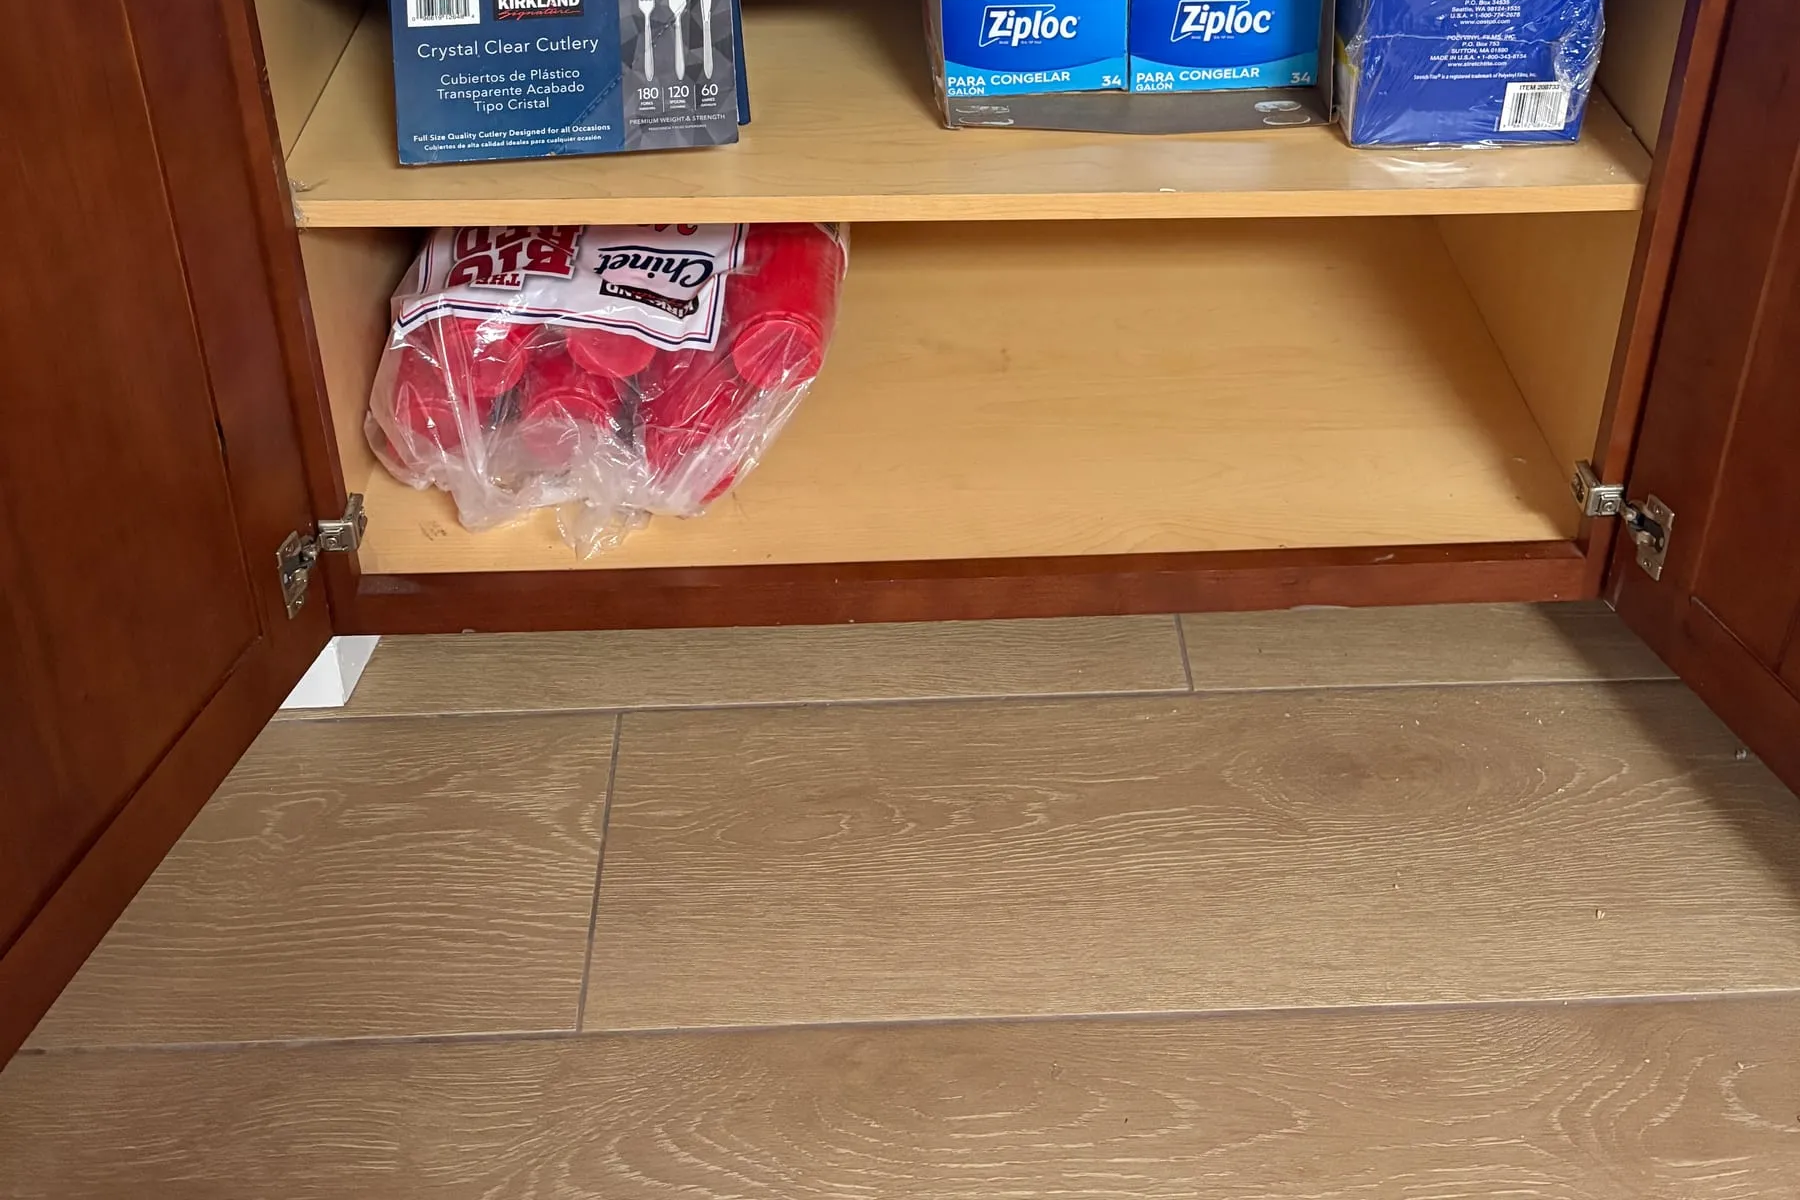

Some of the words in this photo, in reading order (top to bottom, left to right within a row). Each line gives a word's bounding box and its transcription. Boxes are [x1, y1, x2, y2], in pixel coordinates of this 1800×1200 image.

[498, 7, 581, 20] Signature
[988, 9, 1078, 47] Ziploc
[1180, 4, 1272, 42] Ziploc
[417, 40, 478, 61] Crystal
[485, 40, 530, 54] Clear
[536, 36, 599, 53] Cutlery
[440, 73, 505, 86] Cubiertos
[510, 70, 526, 82] de
[530, 68, 580, 80] Plástico
[948, 76, 986, 87] PARA
[990, 71, 1070, 85] CONGELAR
[1102, 75, 1122, 87] 34
[1136, 72, 1175, 83] PARA
[1179, 68, 1260, 81] CONGELAR
[1290, 72, 1311, 84] 34
[437, 87, 522, 100] Transparente
[526, 81, 585, 95] Acabado
[637, 87, 659, 100] 180
[668, 85, 690, 98] 120
[701, 83, 719, 96] 60
[948, 86, 985, 95] GALÓN
[1136, 81, 1172, 92] GALÓN
[474, 101, 503, 114] Tipo
[508, 97, 550, 110] Cristal
[629, 117, 659, 125] PREMIUM
[413, 134, 428, 142] Full
[429, 133, 446, 141] Size
[447, 132, 477, 141] Quality
[478, 130, 507, 139] Cutlery
[509, 128, 546, 138] Designed
[547, 126, 559, 134] for
[560, 125, 571, 133] all
[572, 124, 611, 133] Occasions
[424, 143, 456, 151] Cubiertos
[546, 136, 576, 145] cualquier
[594, 253, 714, 288] Chinet
